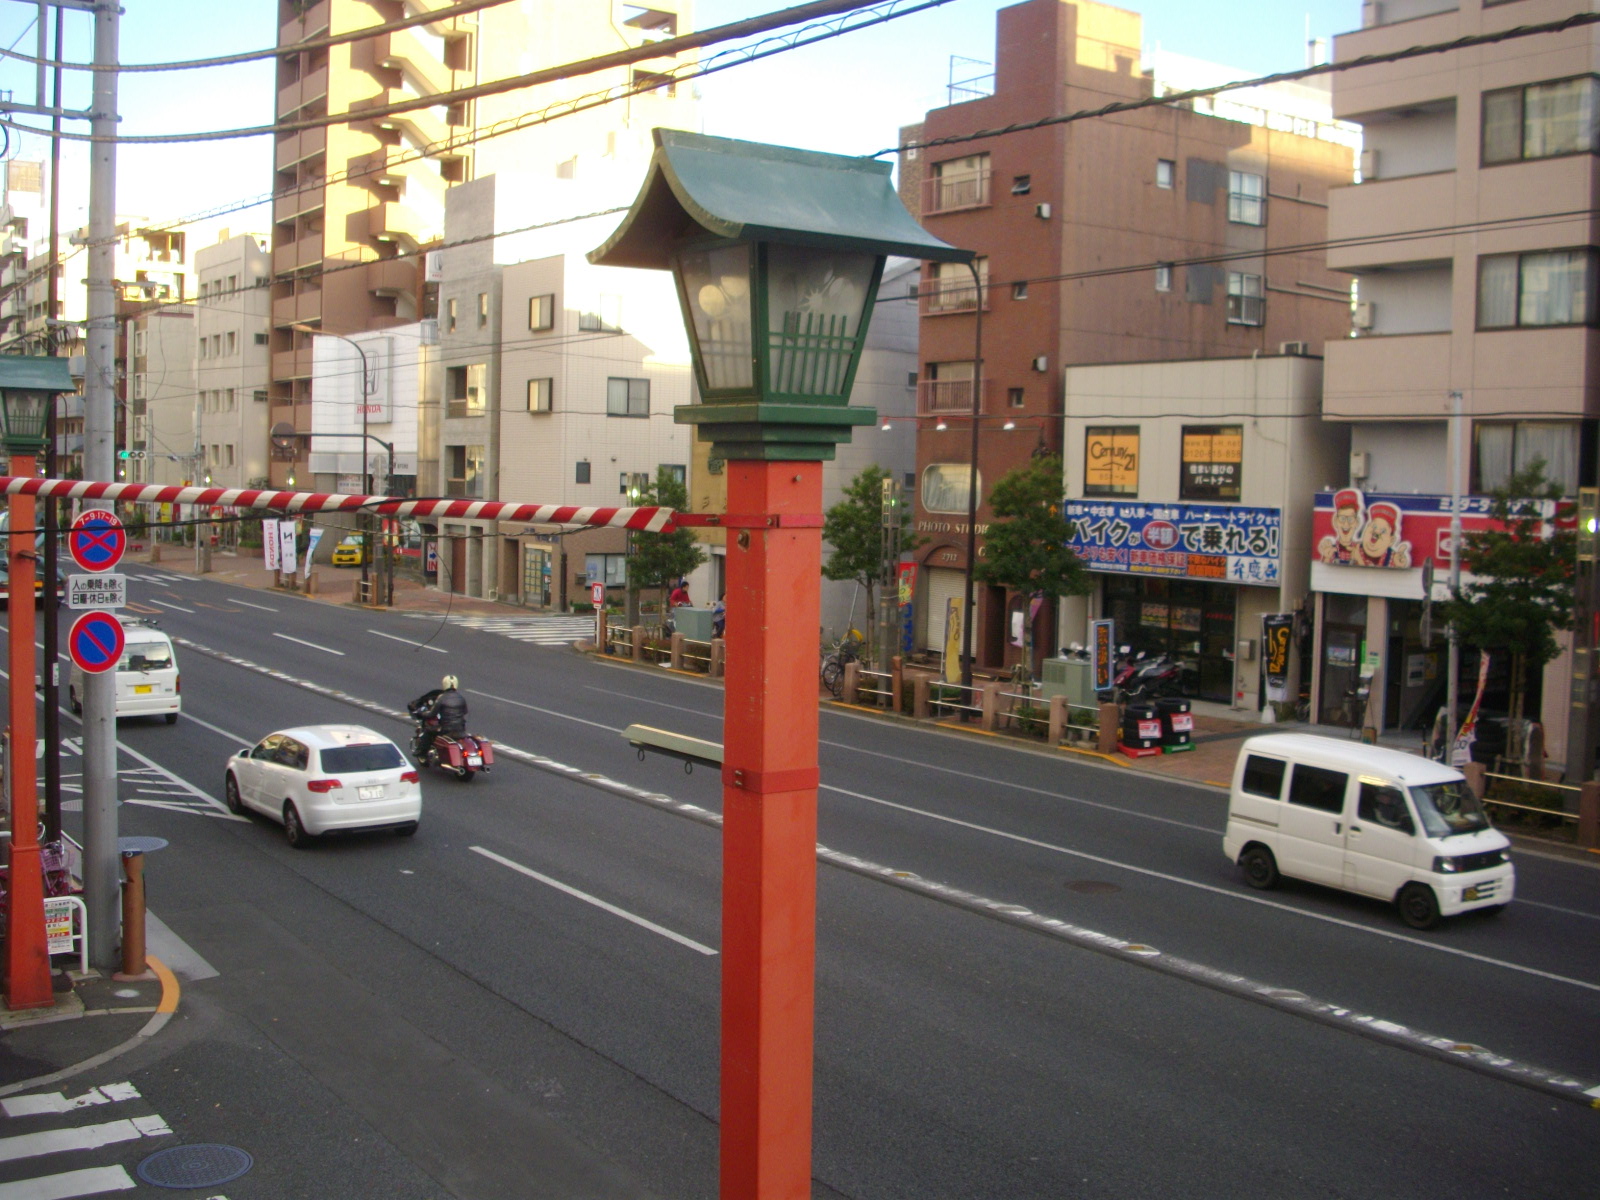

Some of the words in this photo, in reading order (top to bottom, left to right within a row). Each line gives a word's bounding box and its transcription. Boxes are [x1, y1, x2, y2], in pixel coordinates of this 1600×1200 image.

[1091, 441, 1129, 460] Century
[1124, 453, 1136, 471] 21
[918, 520, 951, 533] PHOTO
[942, 552, 958, 562] 2712
[428, 560, 438, 571] IN
[72, 579, 123, 591] 人の乗降を除く
